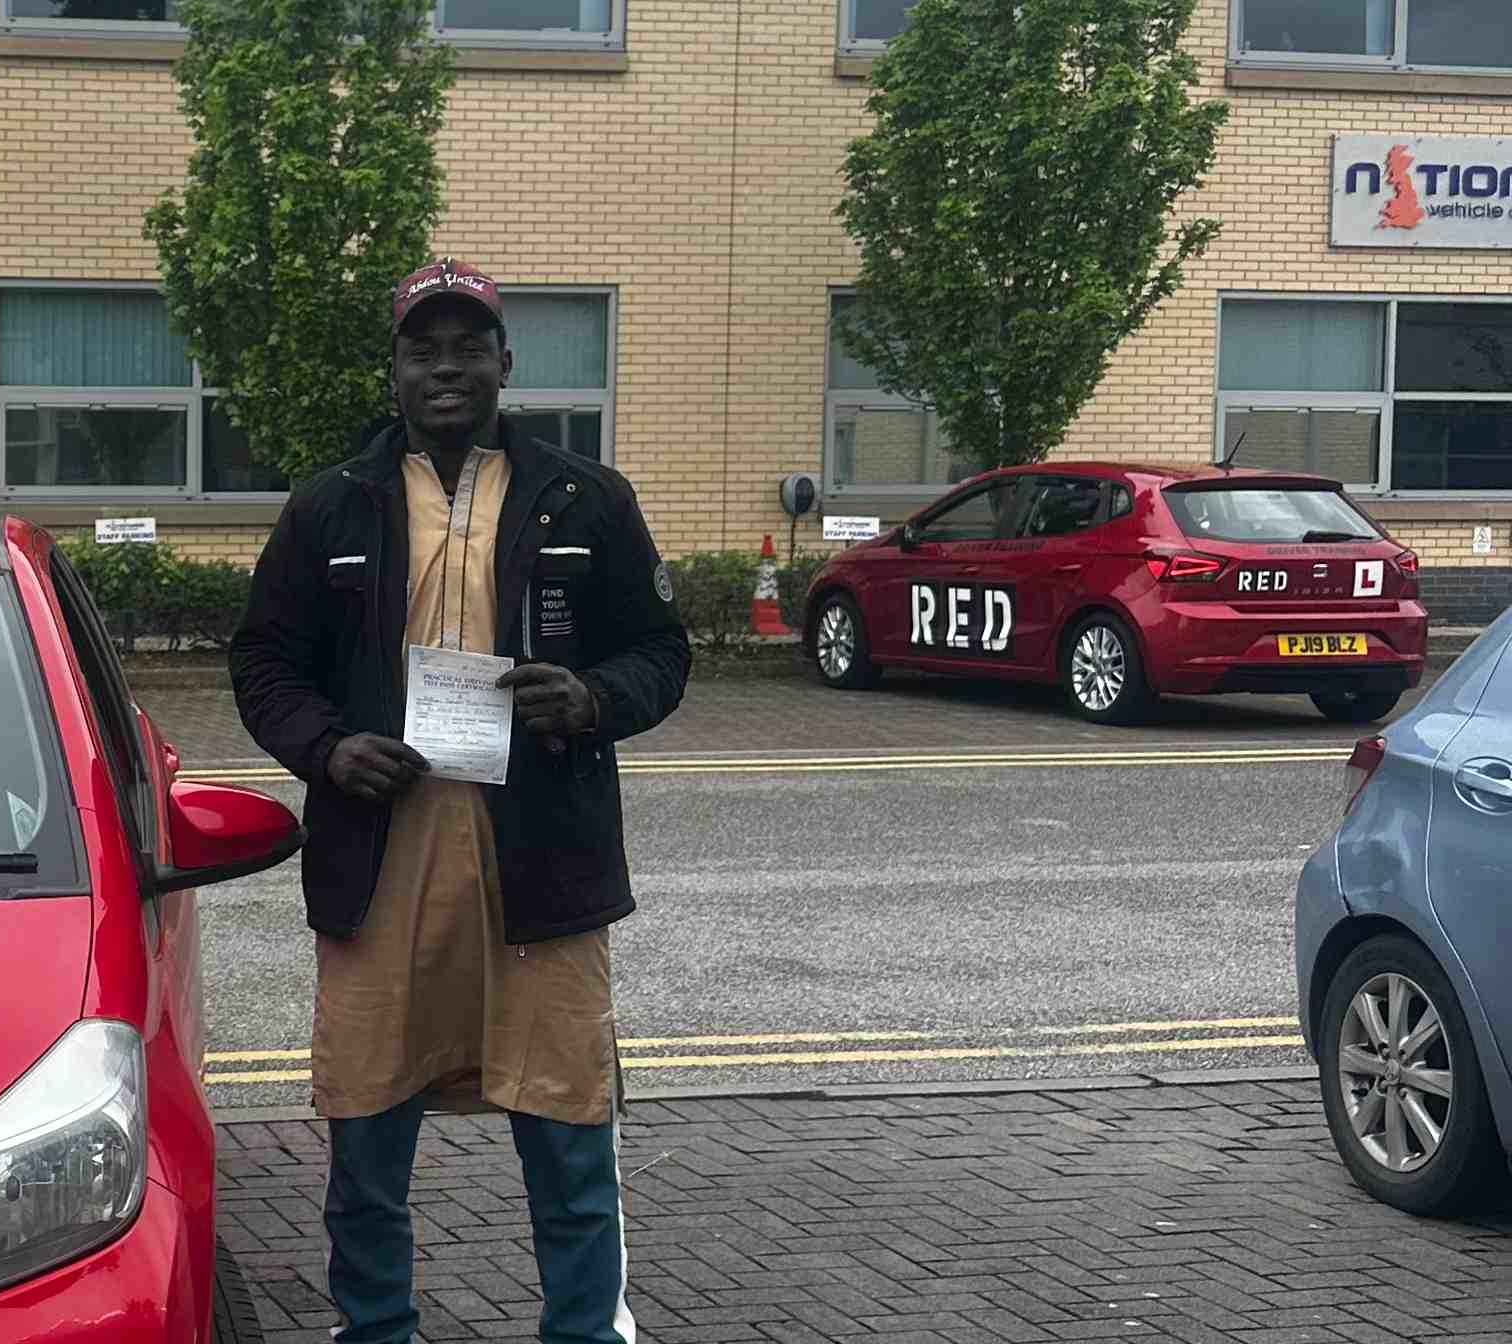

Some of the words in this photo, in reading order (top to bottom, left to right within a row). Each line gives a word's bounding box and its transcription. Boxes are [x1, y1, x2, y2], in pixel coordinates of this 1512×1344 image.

[1427, 202, 1503, 219] vehicle
[1237, 570, 1288, 592] RED
[1361, 568, 1377, 589] L
[542, 588, 564, 597] FIND
[910, 584, 1012, 651] RED
[1288, 636, 1324, 653] PJ19
[1328, 636, 1358, 653] BLZ
